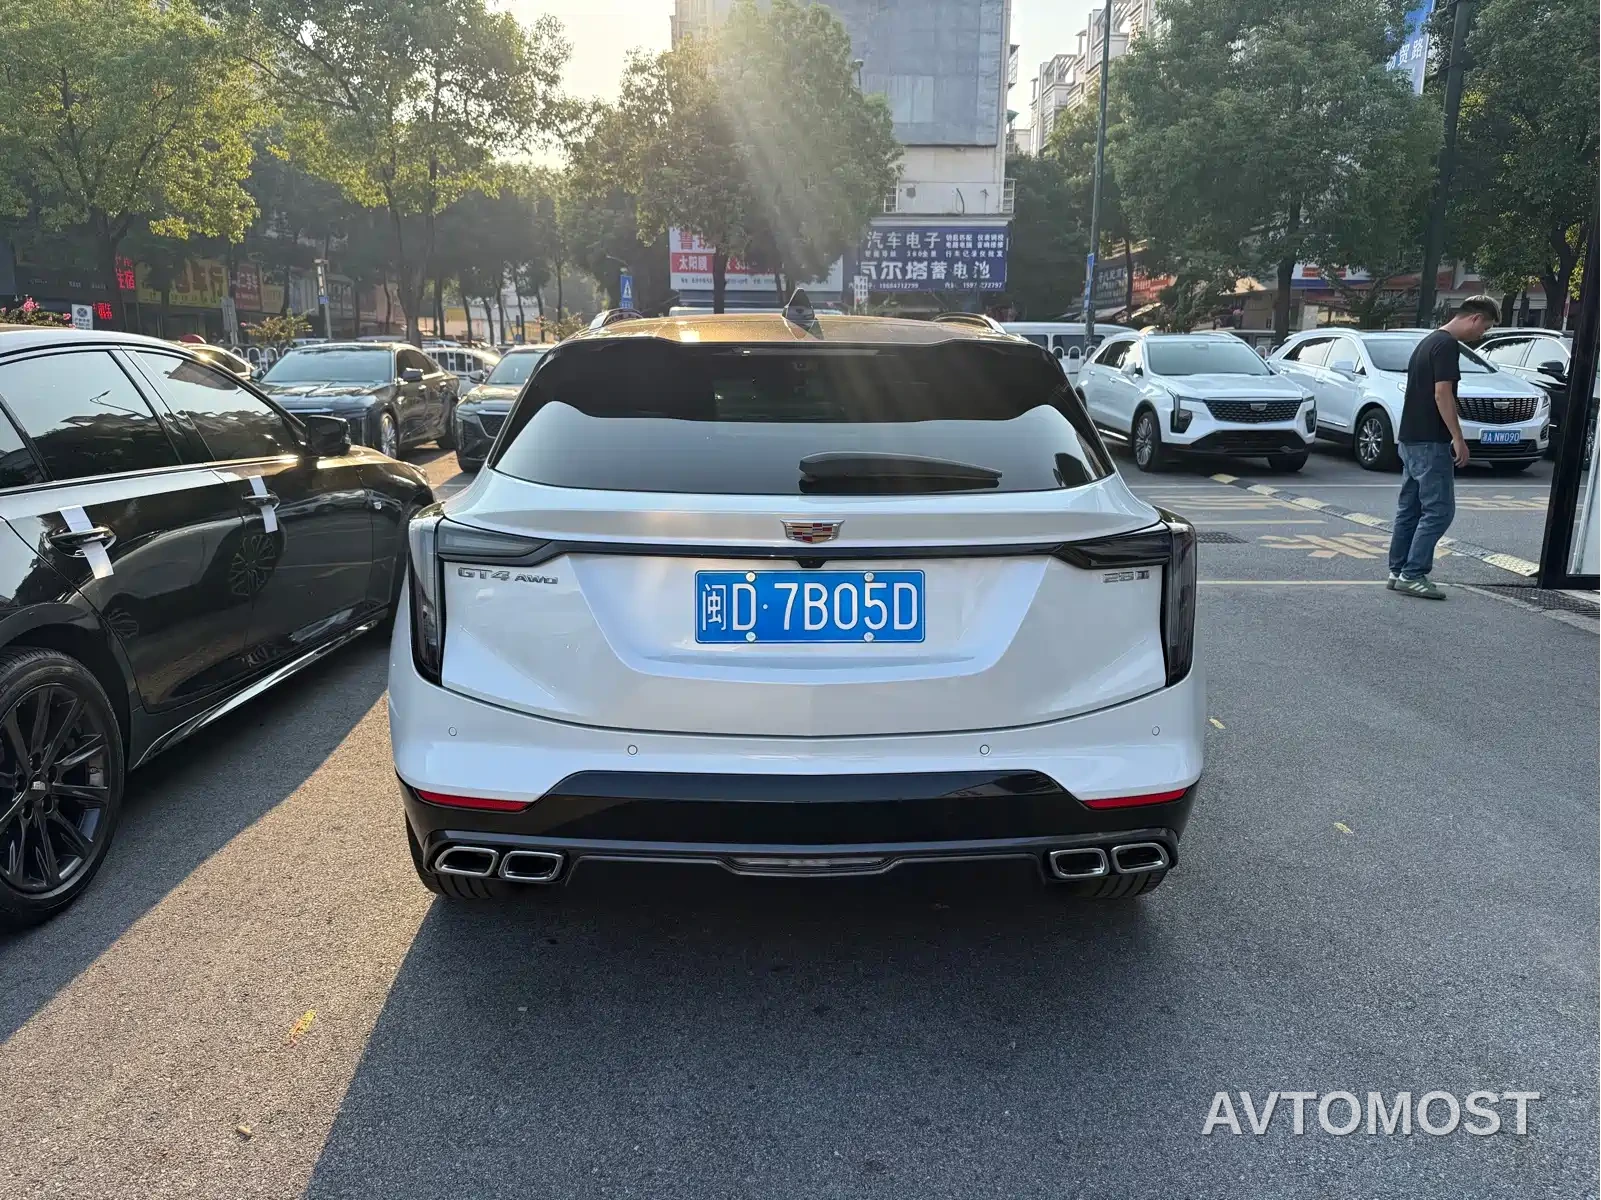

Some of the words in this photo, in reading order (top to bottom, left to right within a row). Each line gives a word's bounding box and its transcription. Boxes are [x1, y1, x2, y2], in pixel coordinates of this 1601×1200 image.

[867, 231, 941, 249] 汽车电子
[457, 567, 511, 581] GT4
[514, 574, 559, 584] AWD
